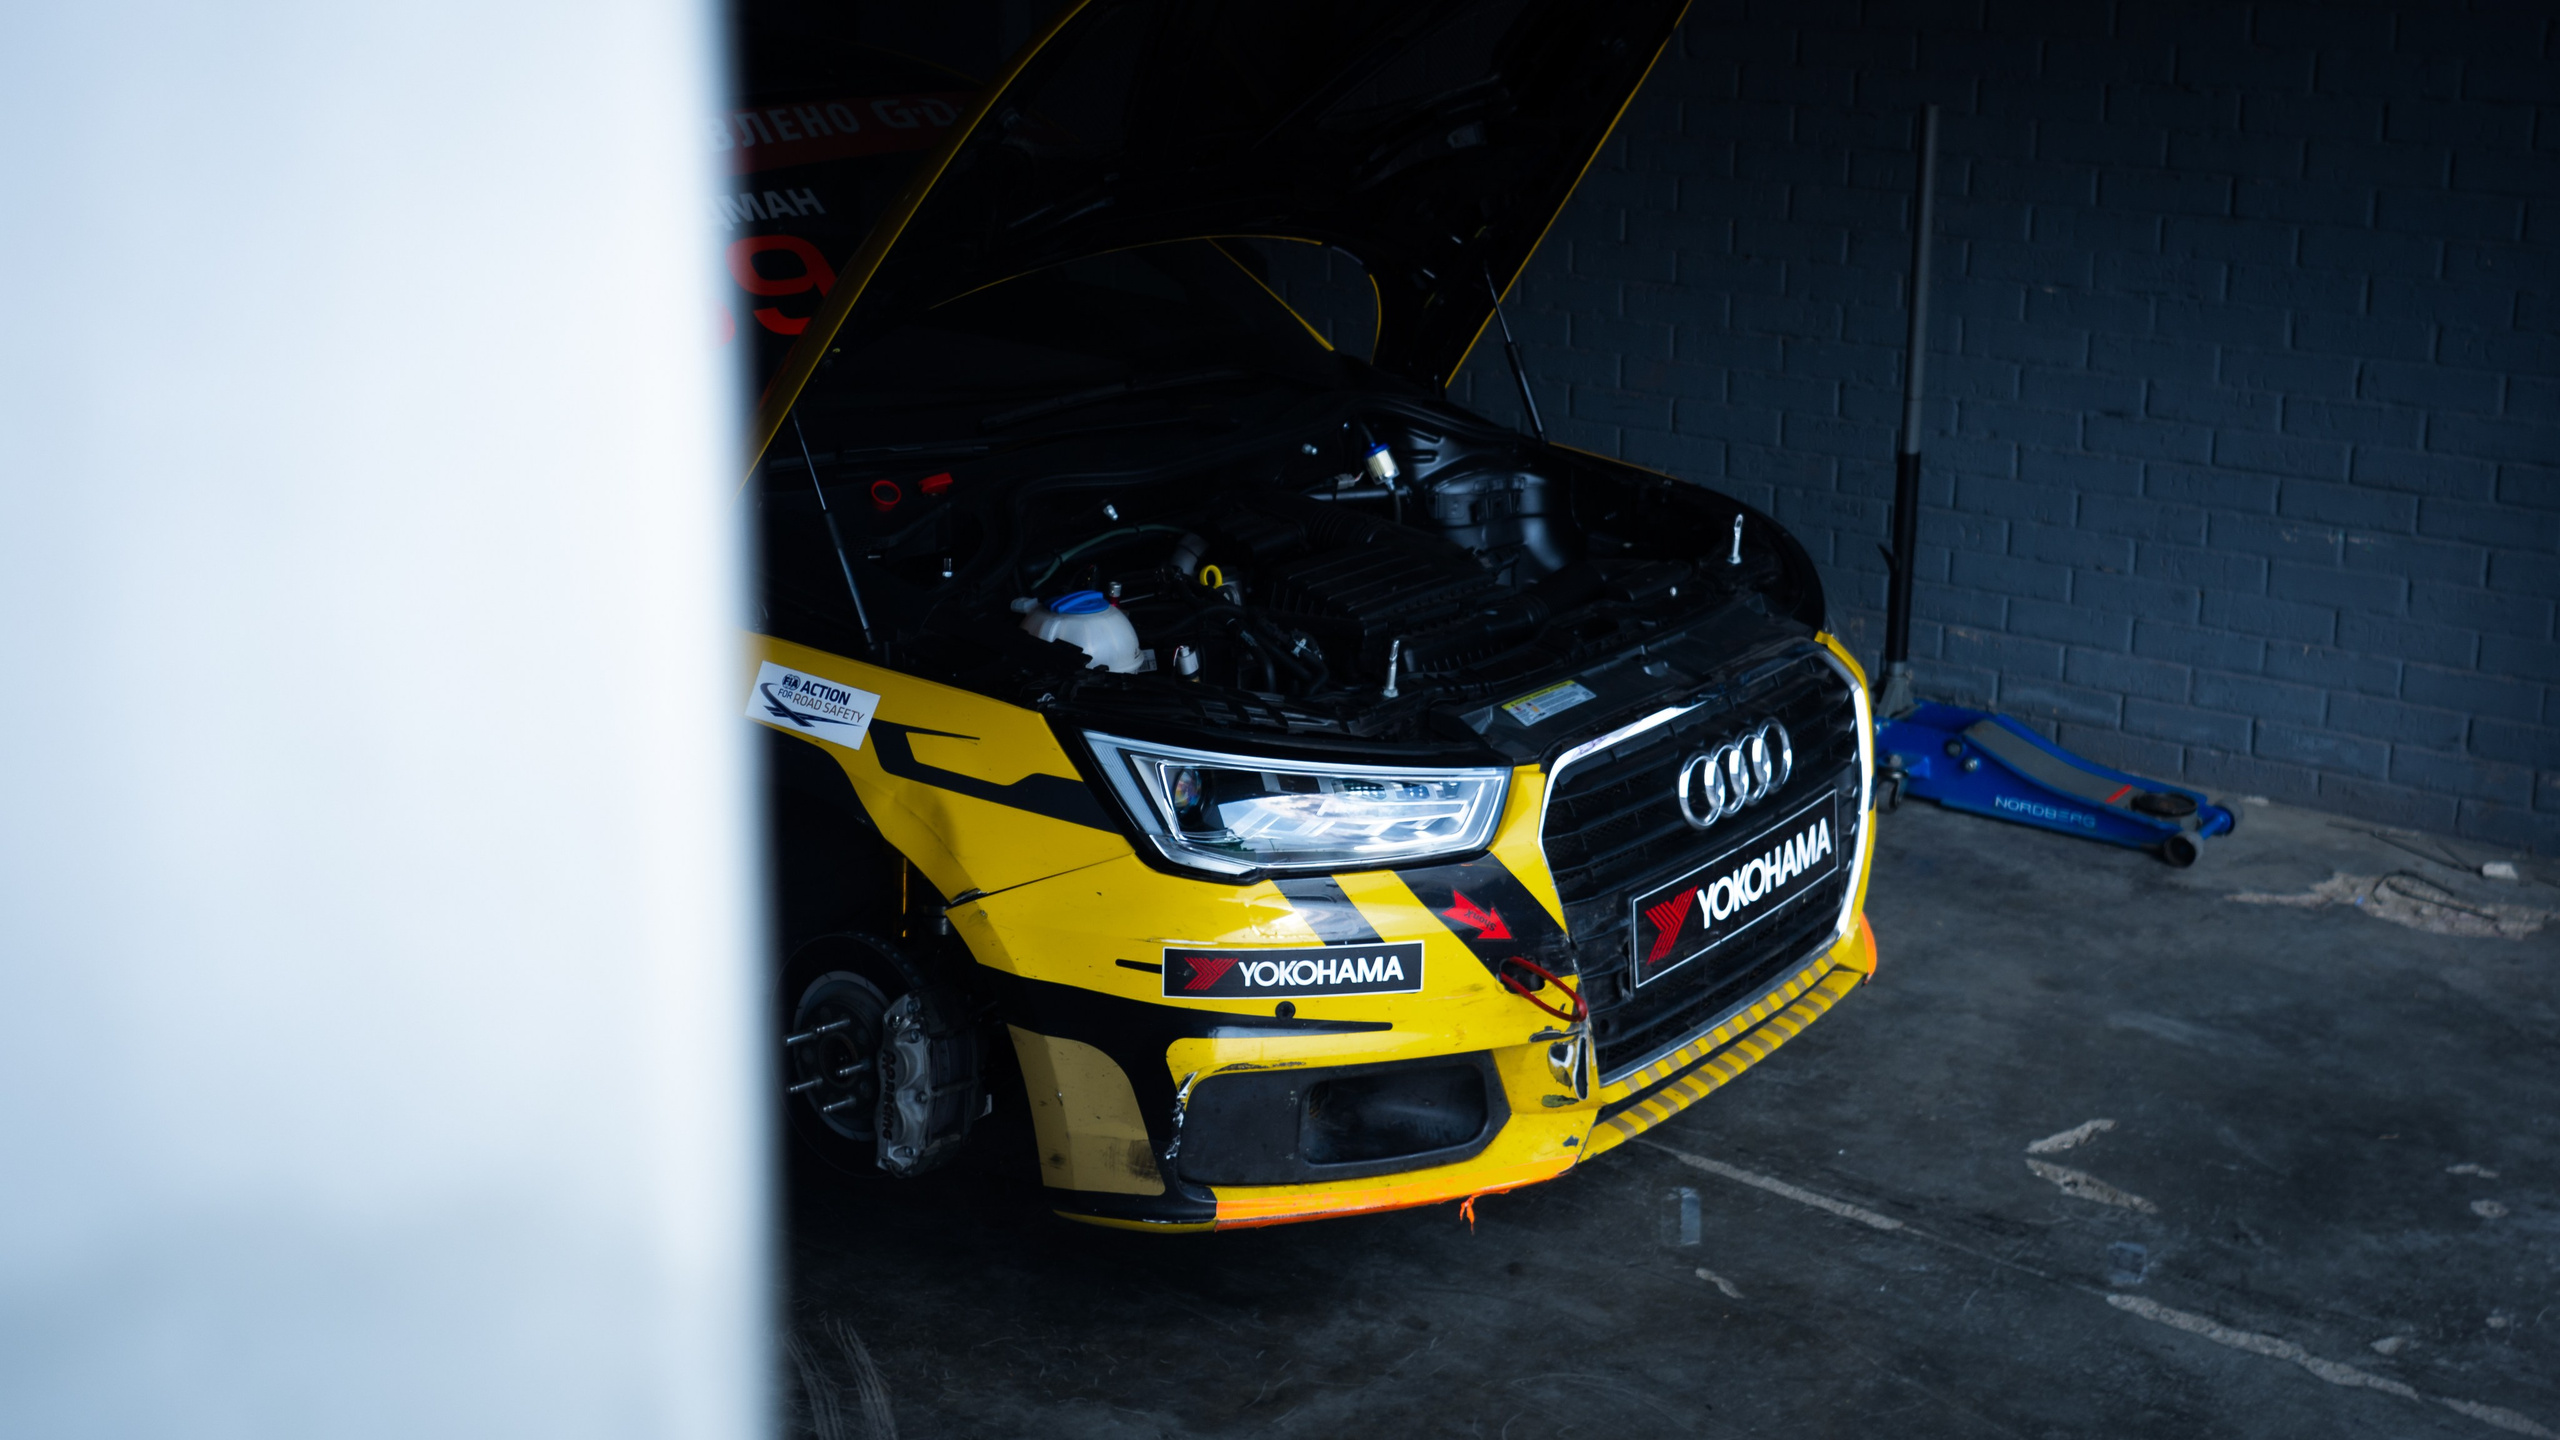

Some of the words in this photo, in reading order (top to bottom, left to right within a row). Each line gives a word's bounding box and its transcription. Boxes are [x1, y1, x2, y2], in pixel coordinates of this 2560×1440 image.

[704, 234, 838, 348] 9
[777, 688, 793, 700] FOR
[792, 693, 822, 711] ROAD
[822, 702, 865, 723] SAFETY
[781, 675, 800, 689] FIA
[800, 681, 851, 705] ACTION
[1995, 795, 2096, 828] NORDBERG
[1697, 817, 1832, 930] YOKOHAMA
[1238, 955, 1405, 987] YOKOHAMA
